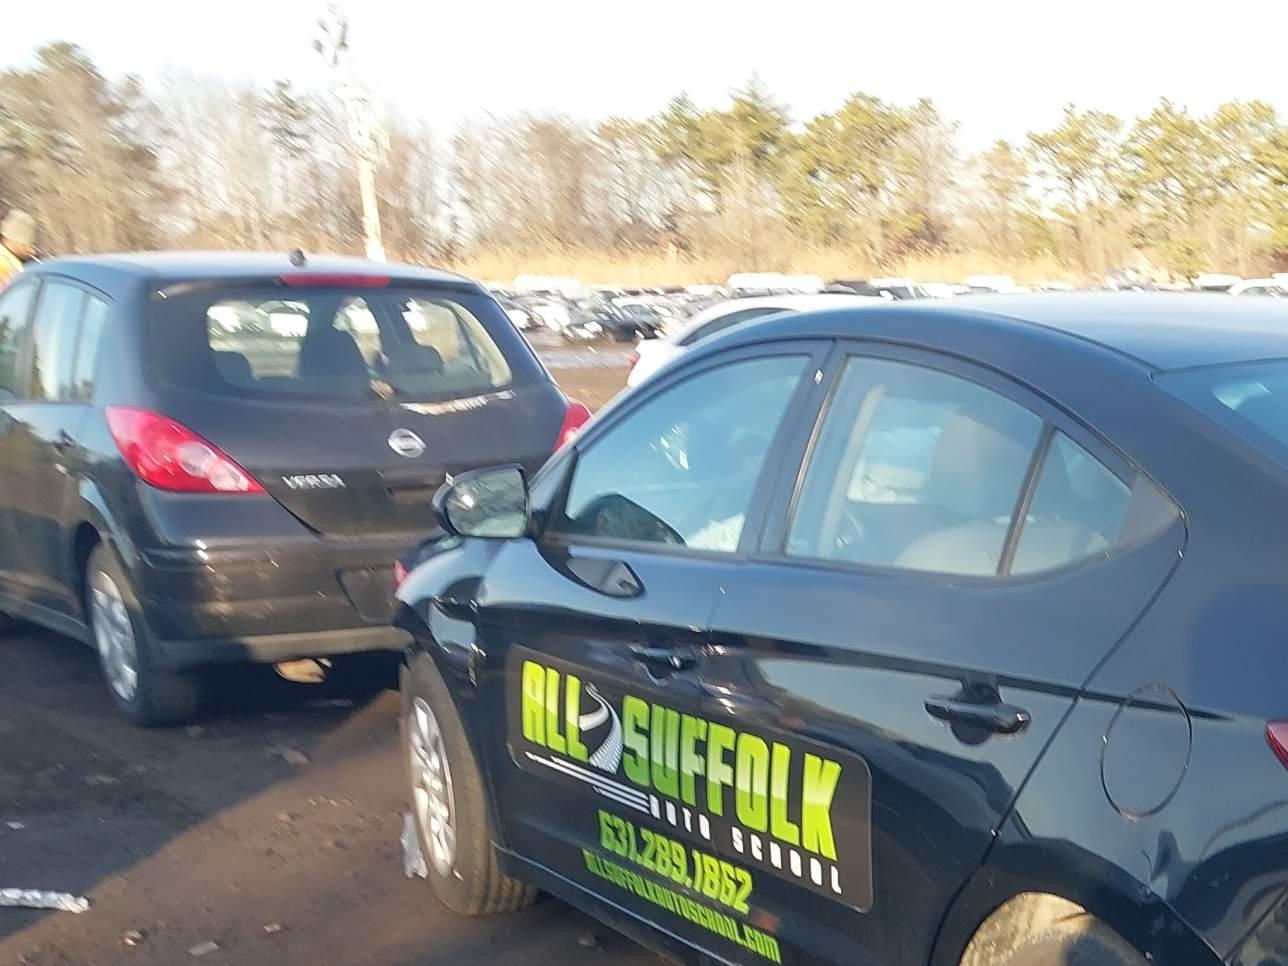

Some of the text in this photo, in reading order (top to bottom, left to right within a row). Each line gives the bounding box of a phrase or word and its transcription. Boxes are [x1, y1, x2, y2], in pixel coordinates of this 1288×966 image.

[522, 660, 842, 862] ALL SUFFOLK
[598, 809, 753, 914] 631.289.1862
[650, 793, 842, 894] AUTO SCHOOL
